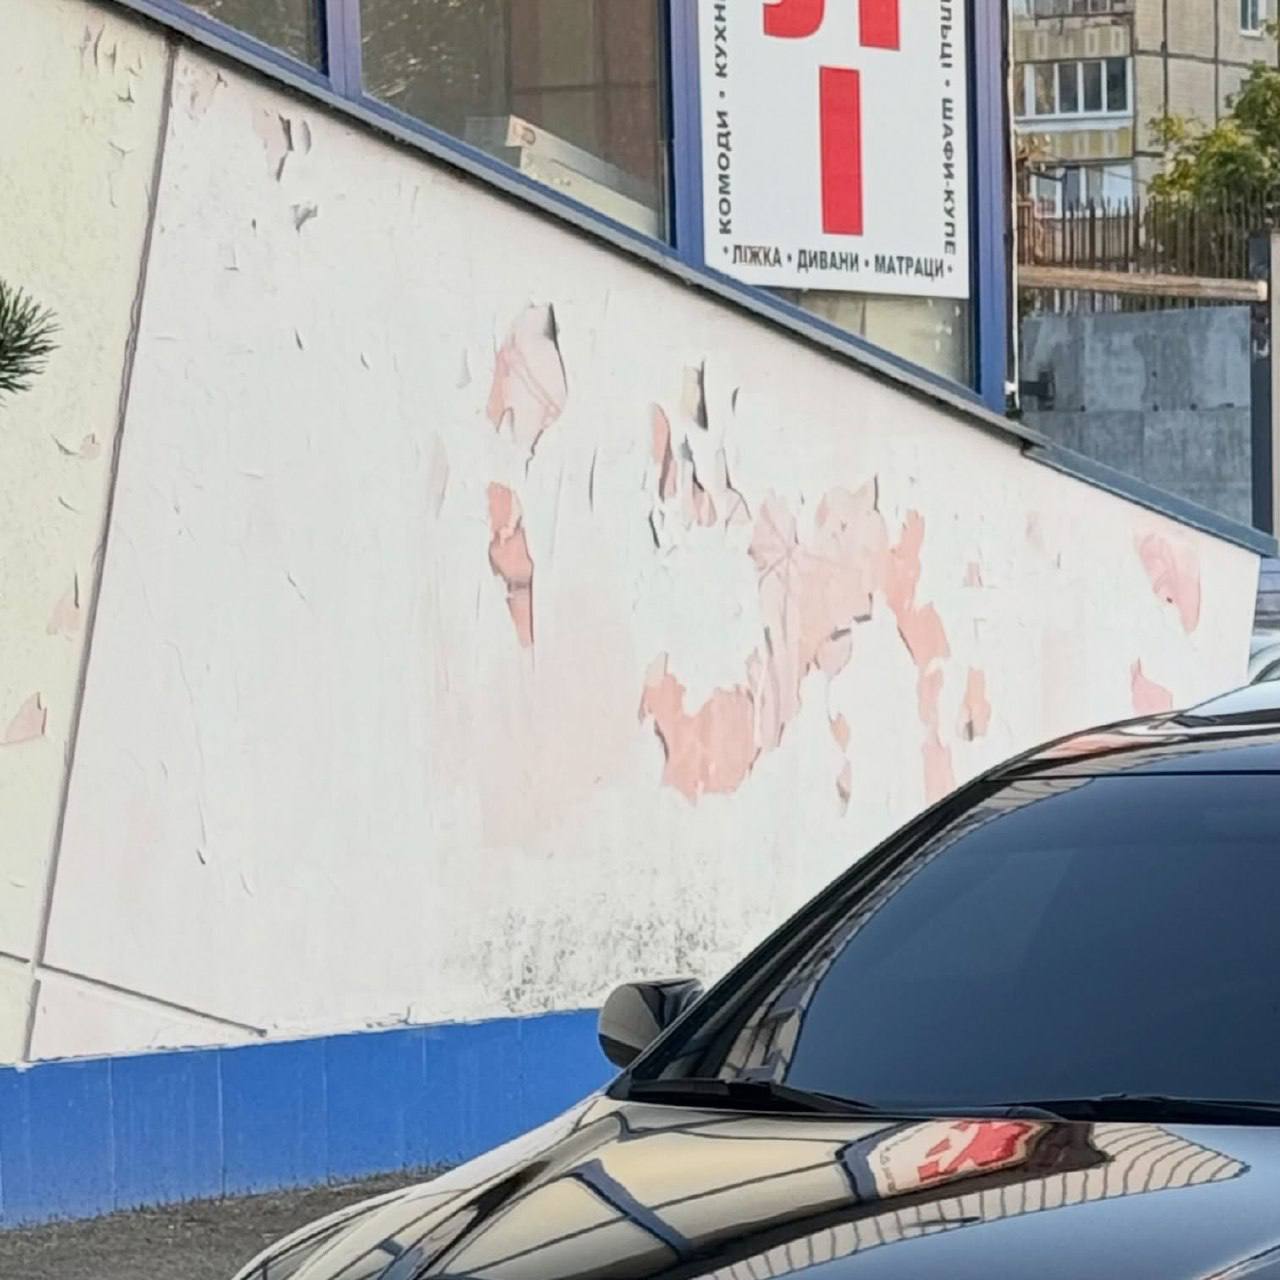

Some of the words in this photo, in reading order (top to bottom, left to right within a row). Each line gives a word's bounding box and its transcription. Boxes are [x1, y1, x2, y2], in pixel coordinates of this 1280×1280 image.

[714, 0, 728, 78] КУХН
[716, 110, 732, 235] КОМОДИ
[941, 98, 956, 255] ШАФИ-КУПЕ
[732, 244, 783, 268] ЛІЖКА
[797, 248, 860, 273] ДИВАНИ
[874, 253, 945, 282] МАТРАЦИ
